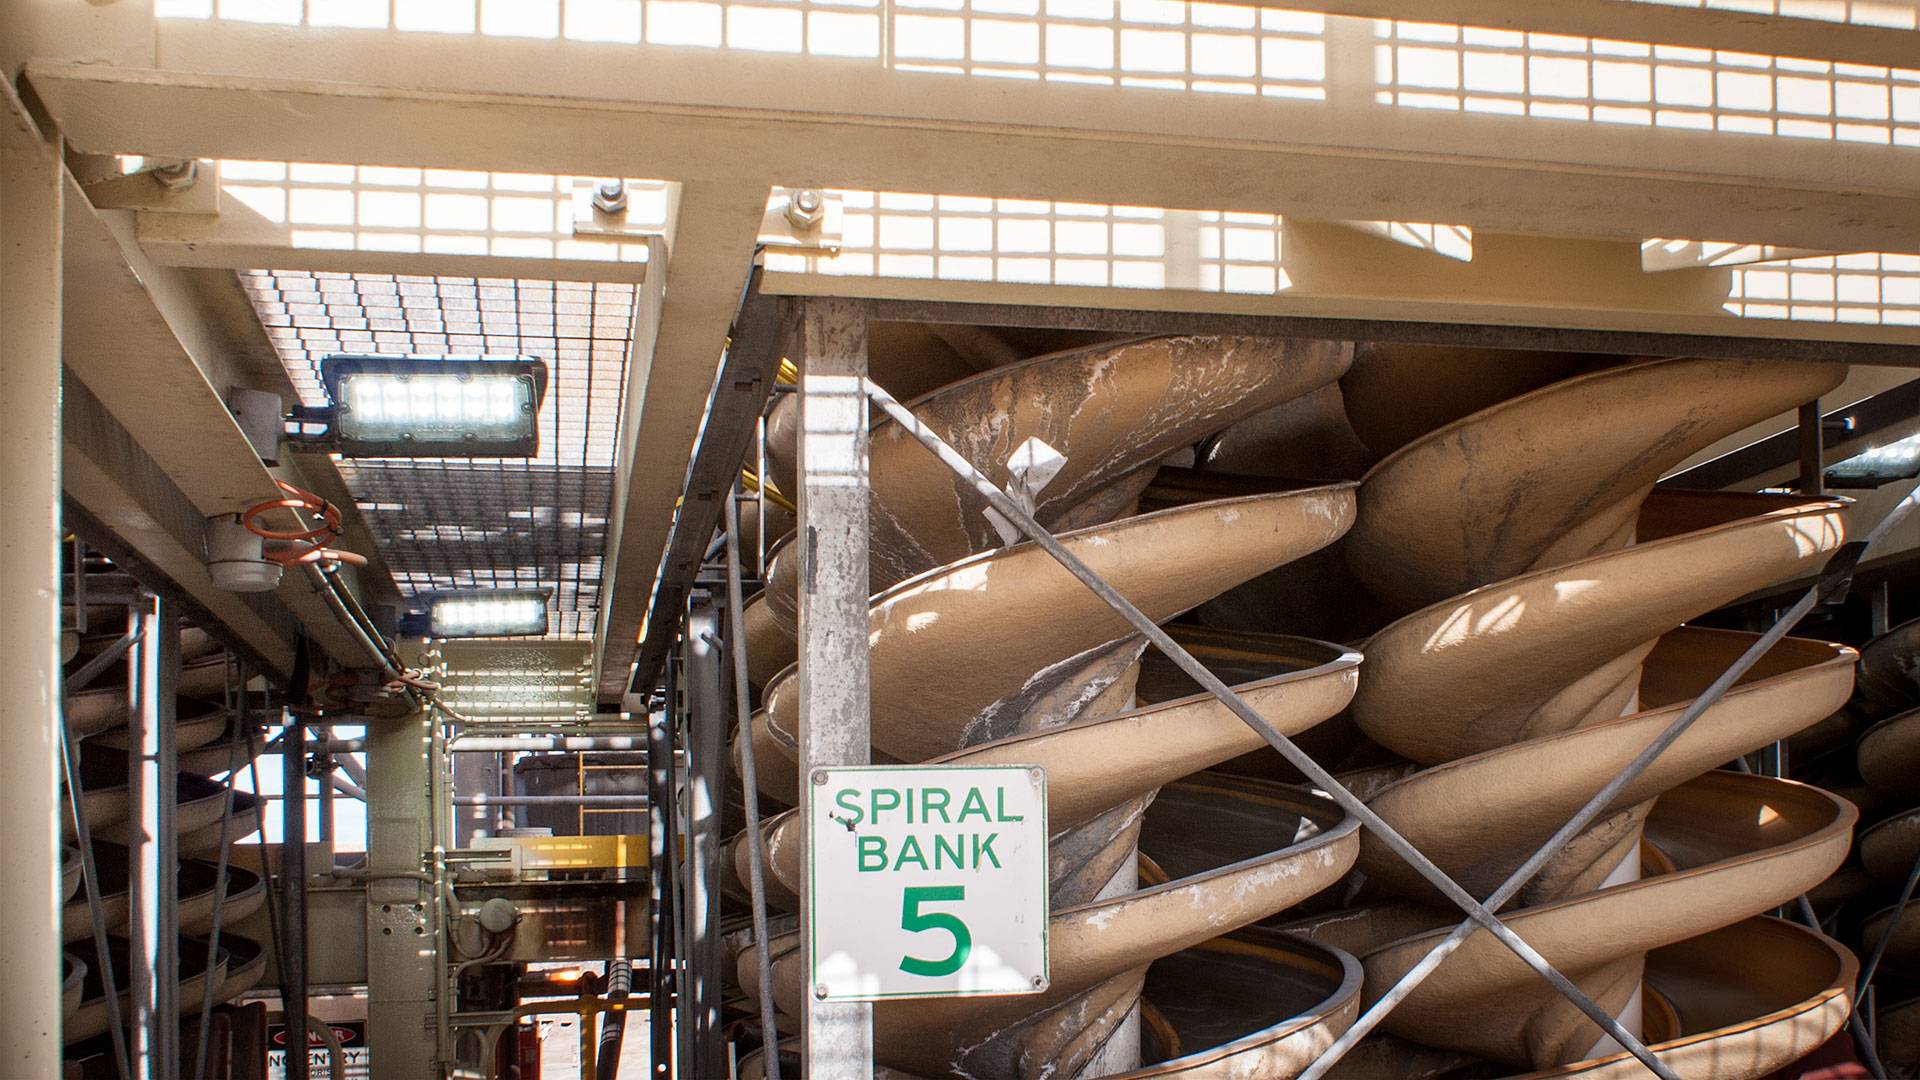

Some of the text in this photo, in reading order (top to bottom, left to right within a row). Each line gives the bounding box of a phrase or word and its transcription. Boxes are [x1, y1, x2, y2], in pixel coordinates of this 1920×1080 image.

[835, 787, 1024, 826] SPIRAL
[858, 833, 1002, 872] BANK
[899, 885, 972, 977] 5
